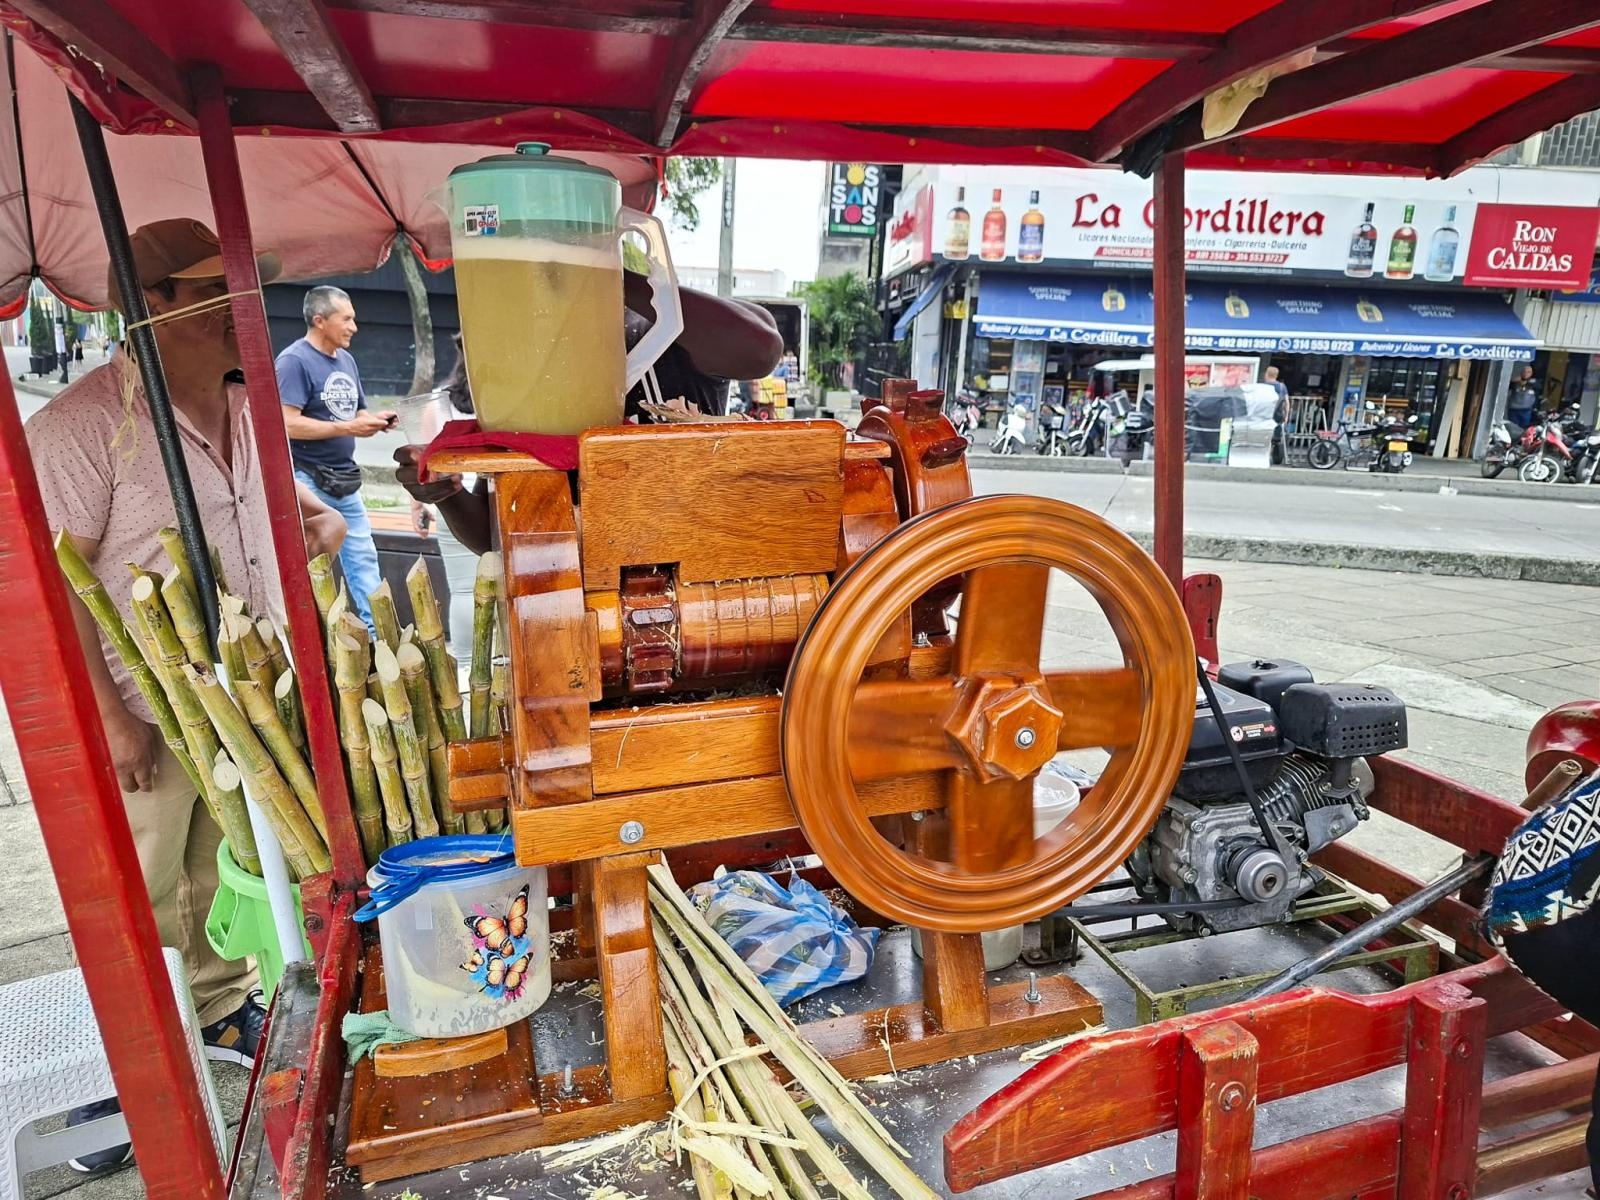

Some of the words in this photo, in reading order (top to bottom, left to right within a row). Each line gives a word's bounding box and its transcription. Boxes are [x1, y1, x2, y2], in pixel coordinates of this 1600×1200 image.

[833, 163, 880, 187] LOS
[1072, 193, 1121, 228] La
[1111, 234, 1154, 244] Nacionale
[1512, 220, 1557, 242] RON
[1487, 247, 1573, 272] CALDAS
[1512, 241, 1538, 253] VIEJO
[1540, 245, 1552, 254] DE
[1049, 326, 1067, 340] La
[1293, 339, 1310, 350] 314
[1435, 343, 1455, 357] La
[1459, 344, 1532, 359] Cordillera
